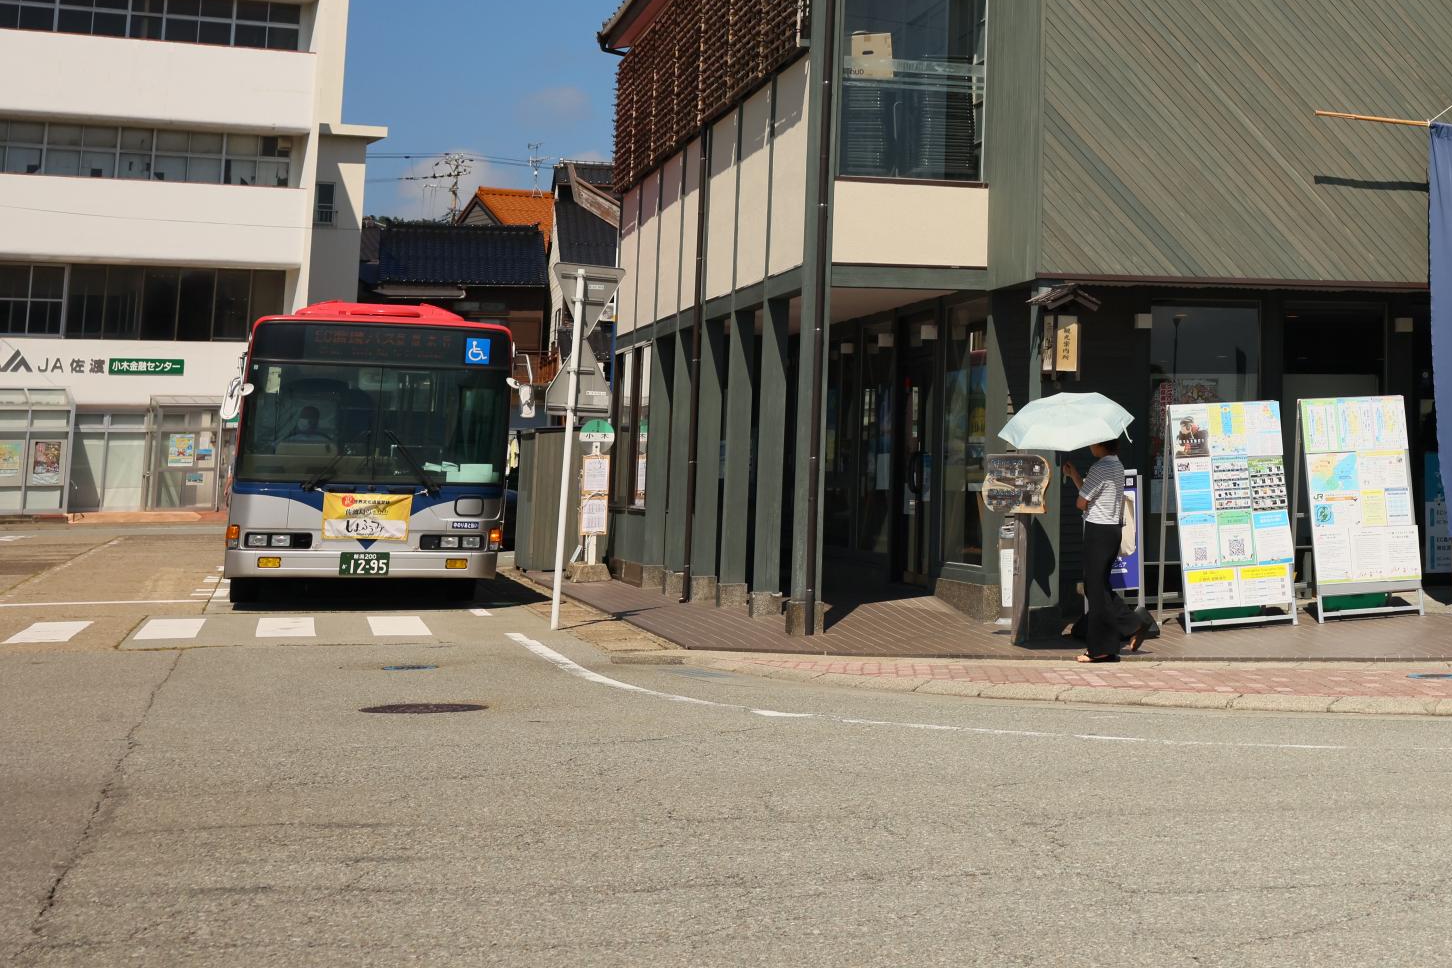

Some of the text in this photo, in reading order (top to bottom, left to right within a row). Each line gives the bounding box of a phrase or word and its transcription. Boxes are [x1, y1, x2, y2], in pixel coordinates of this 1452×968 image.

[38, 358, 105, 374] JA 佐渡
[112, 361, 181, 372] 小木金融センター
[349, 559, 388, 574] 12-95
